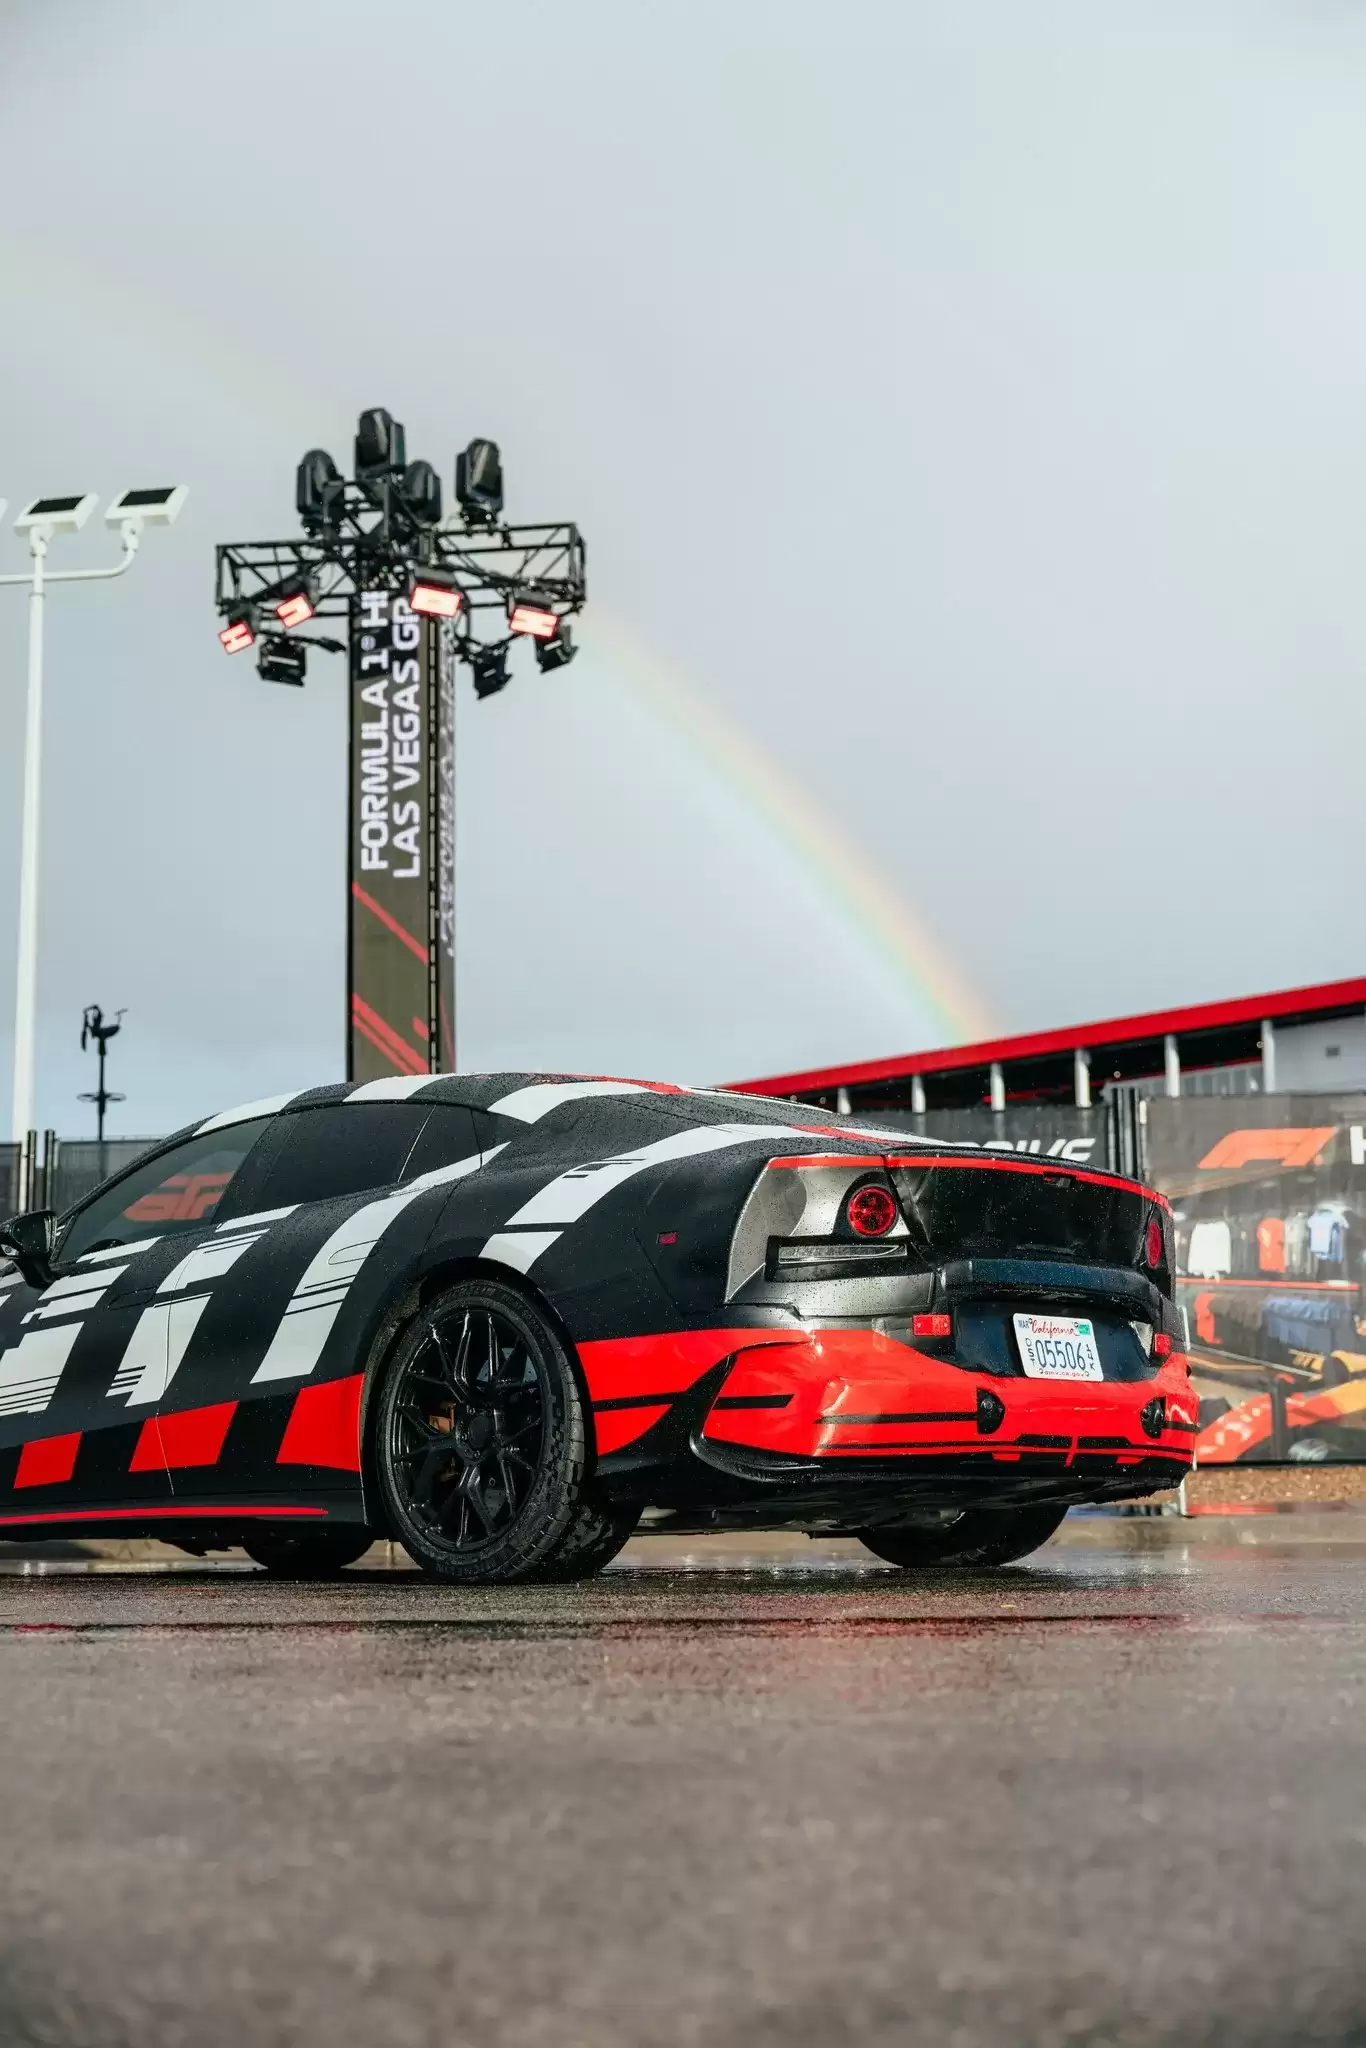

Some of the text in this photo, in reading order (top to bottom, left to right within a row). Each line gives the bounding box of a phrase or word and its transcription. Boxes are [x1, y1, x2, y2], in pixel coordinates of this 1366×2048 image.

[393, 659, 420, 791] VEGAS
[361, 680, 388, 870] FORMULA
[393, 800, 420, 878] LAS
[1031, 1319, 1077, 1338] California
[1035, 1340, 1086, 1371] 05506
